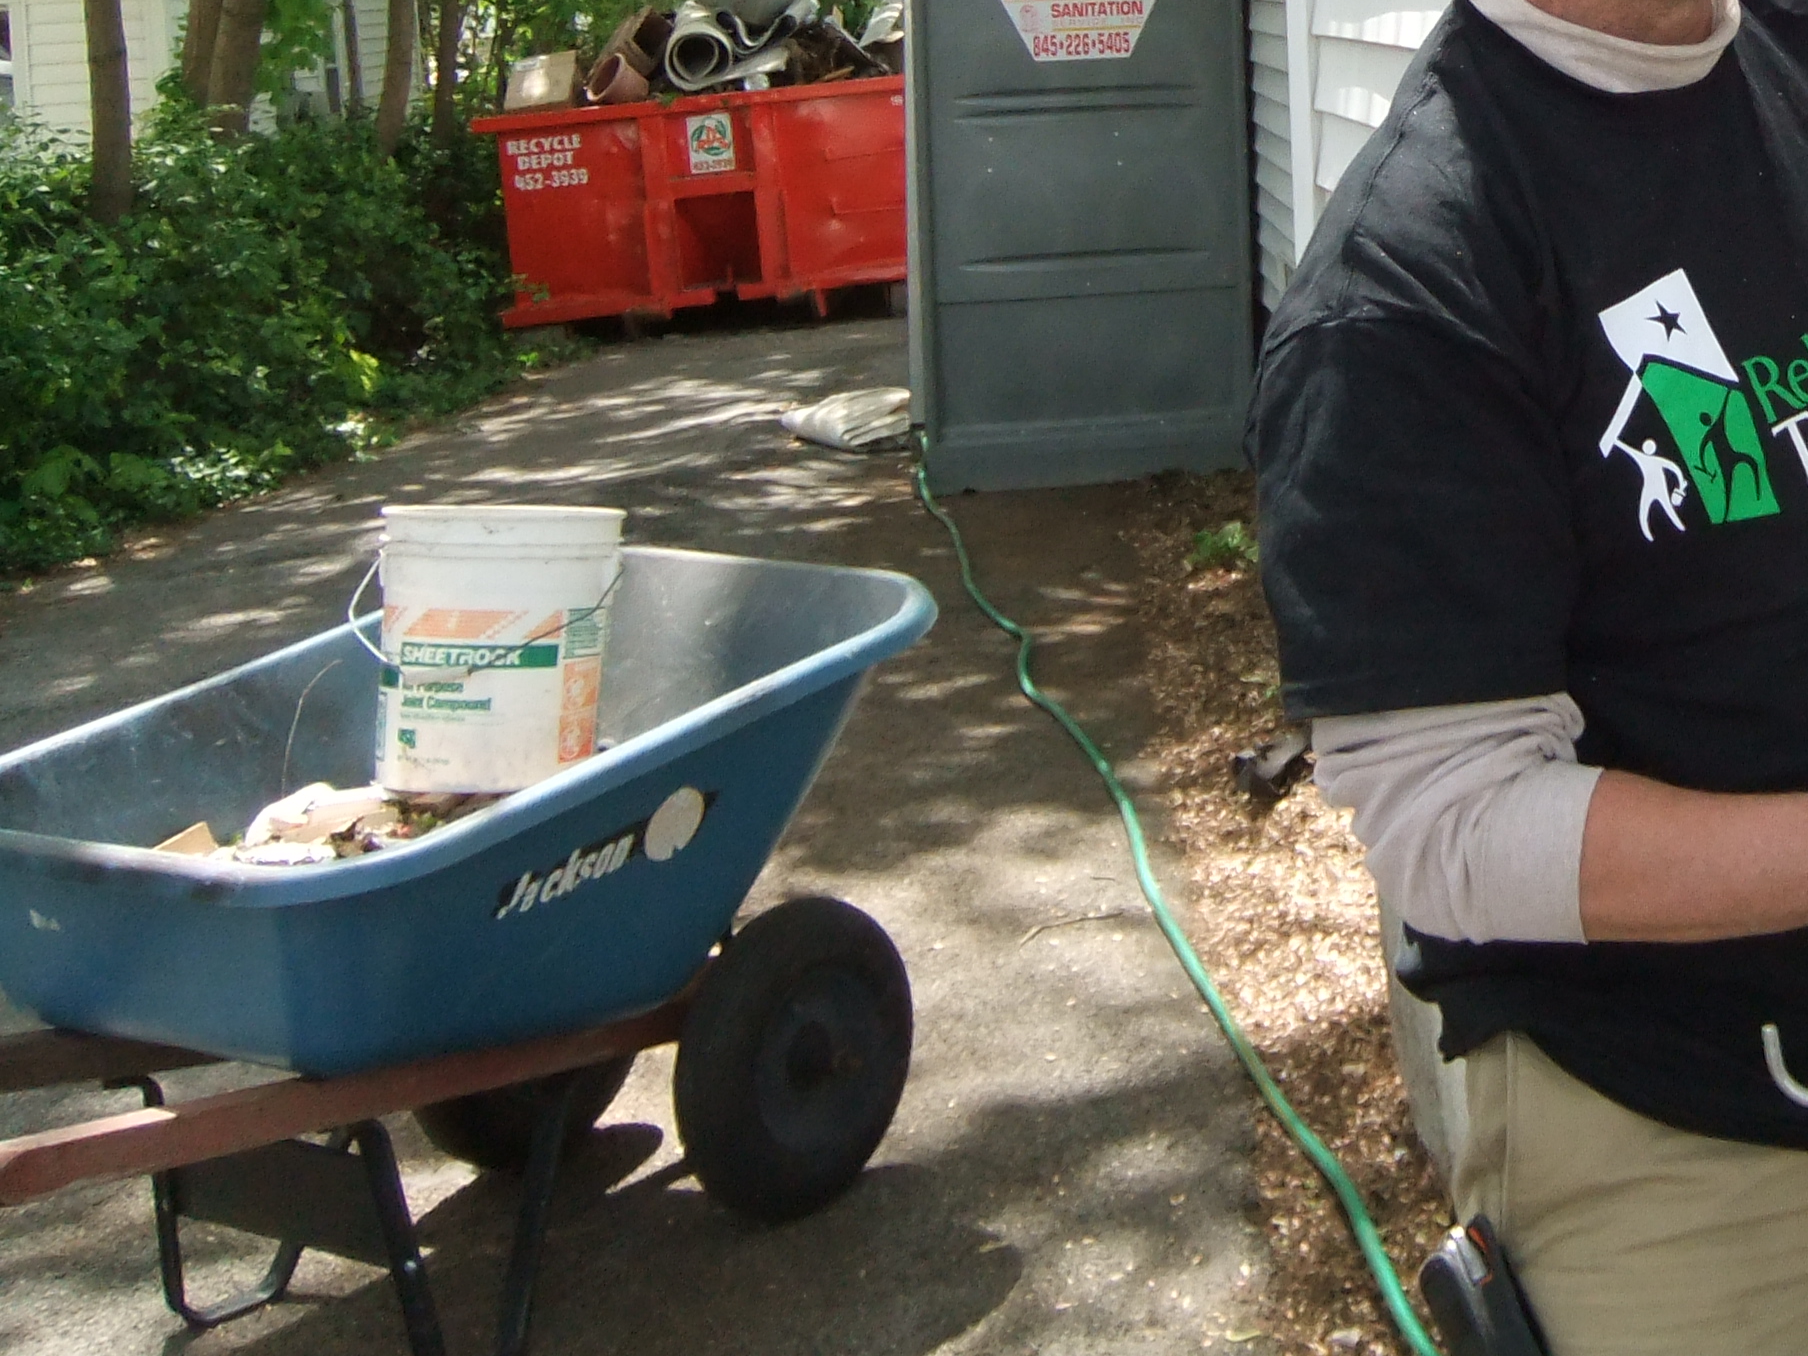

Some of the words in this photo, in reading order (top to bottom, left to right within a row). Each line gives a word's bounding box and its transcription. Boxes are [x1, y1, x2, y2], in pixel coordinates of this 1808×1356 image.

[1051, 0, 1143, 19] SANITATION
[507, 134, 582, 155] RECYCLE
[517, 151, 575, 171] DEPOT
[403, 645, 524, 666] SHEETROCK
[402, 696, 424, 708] Joint
[427, 696, 492, 712] Compound
